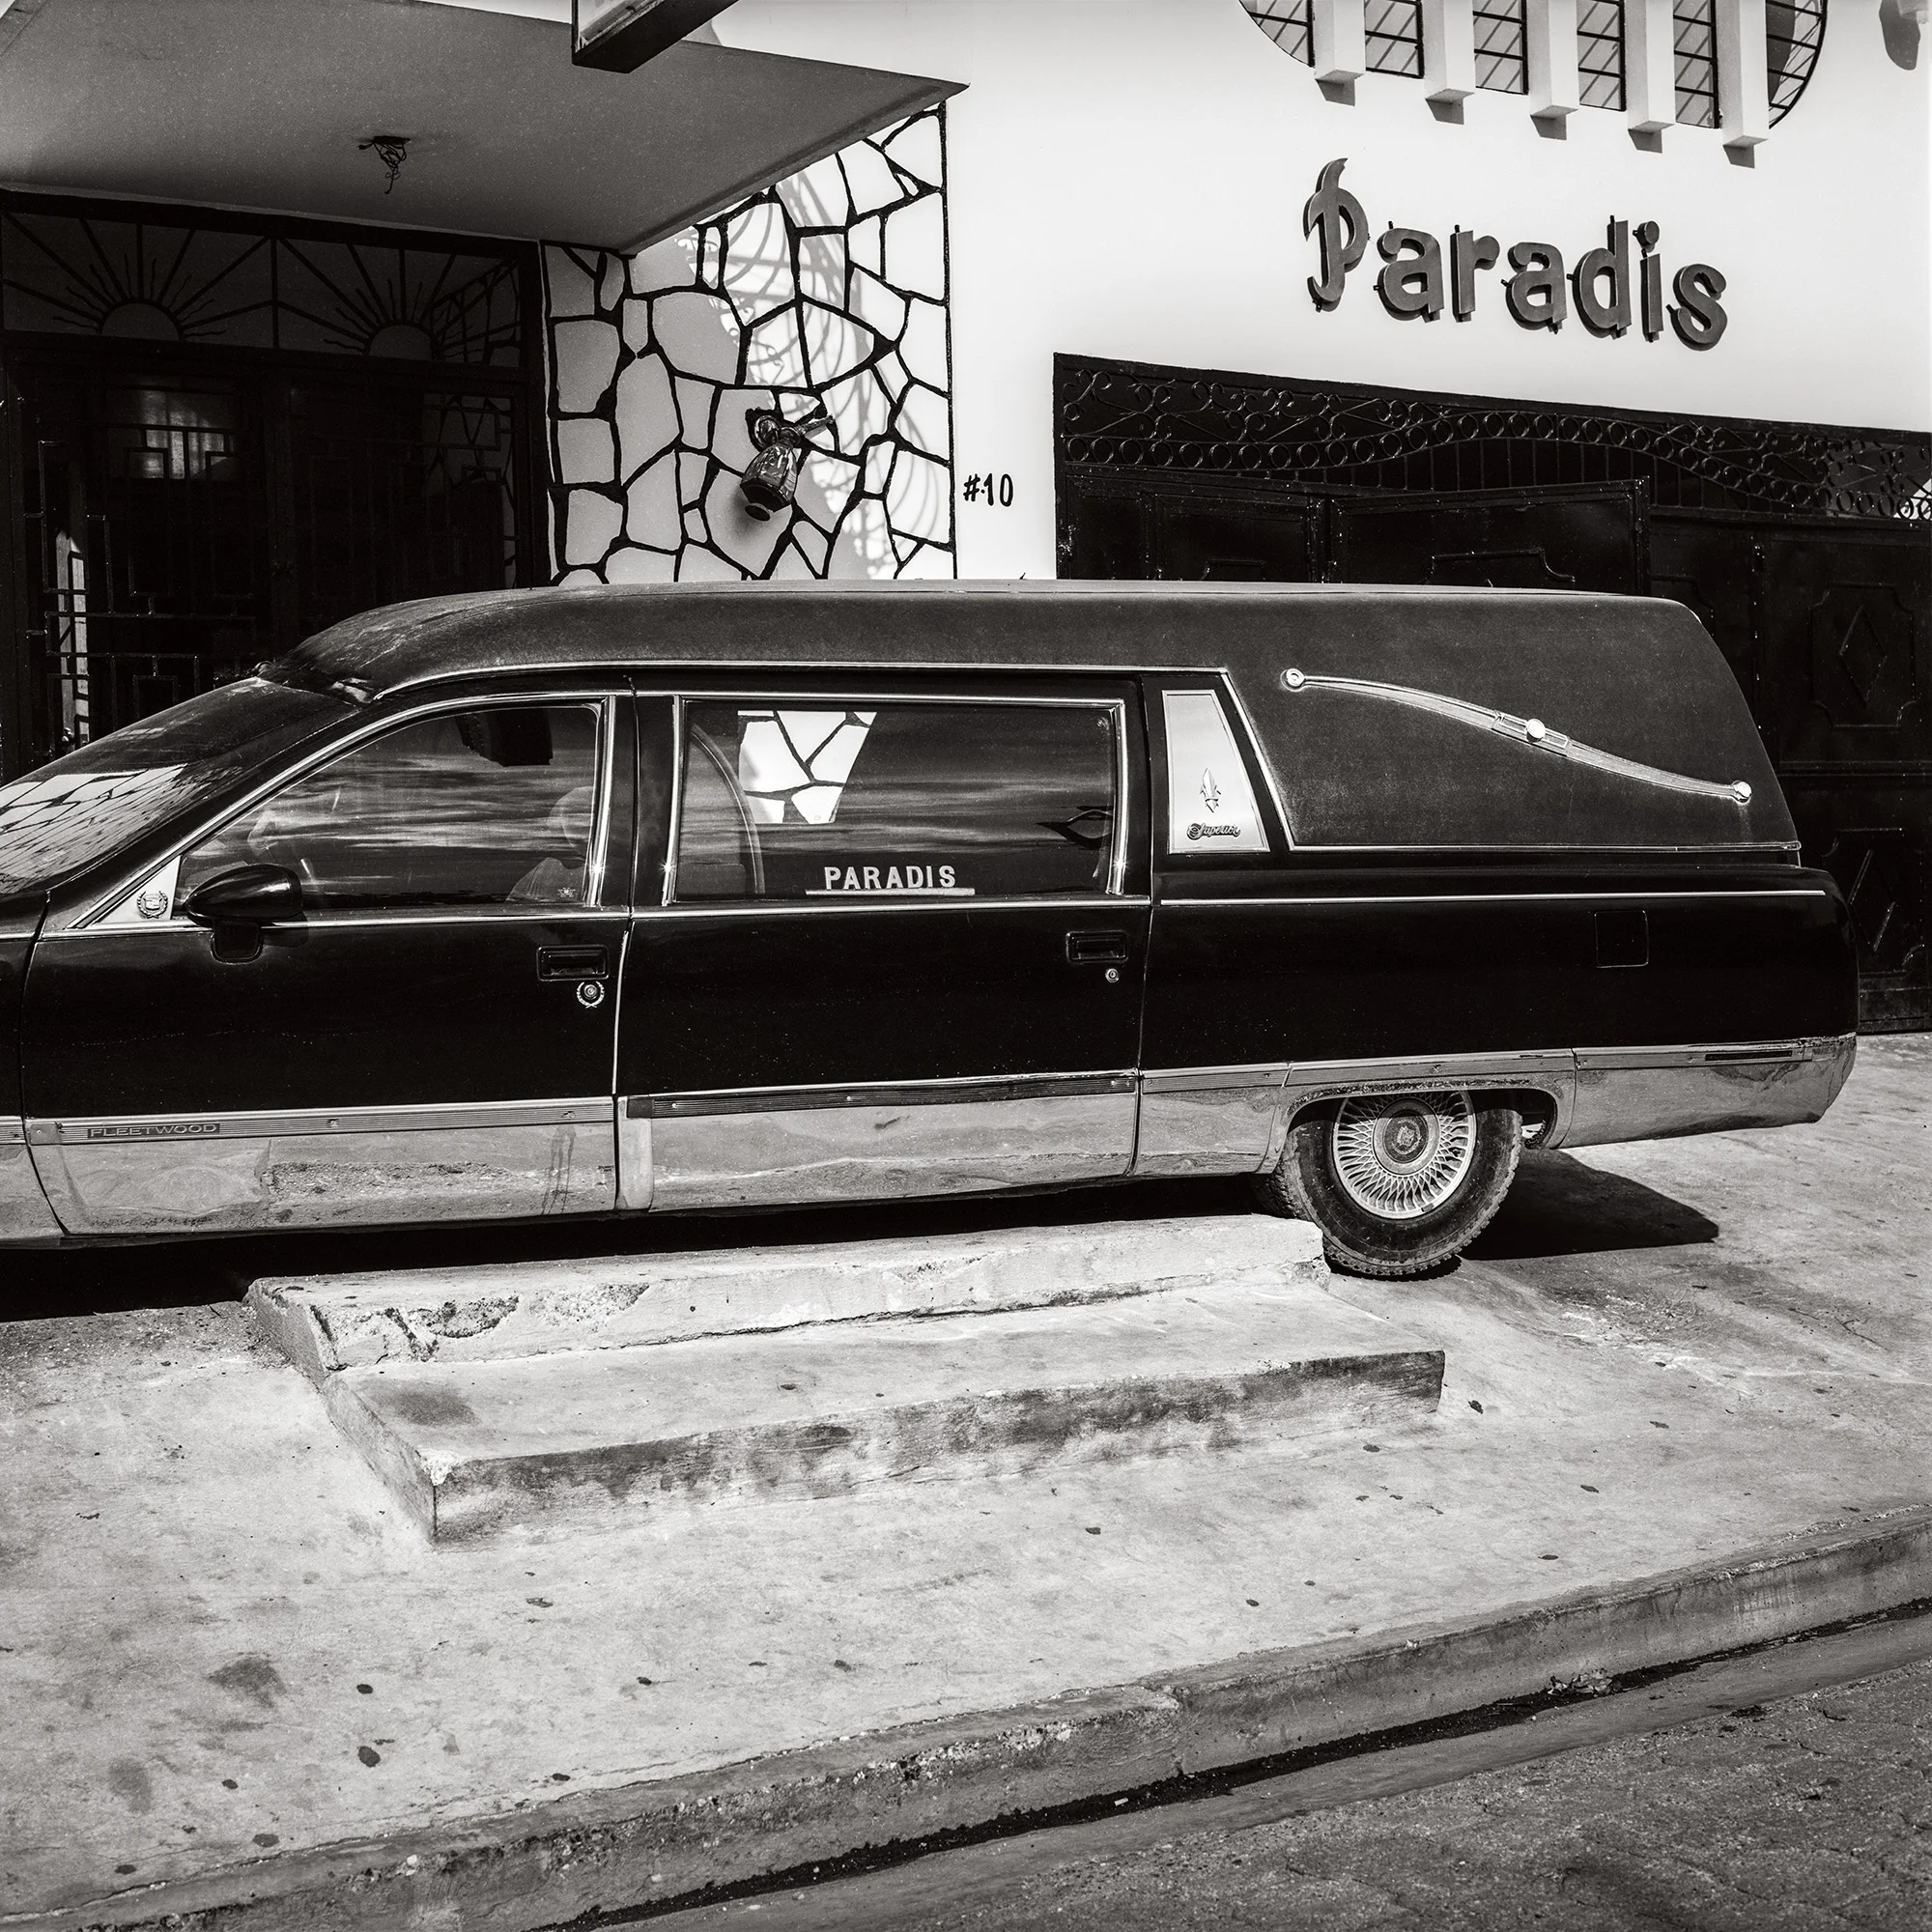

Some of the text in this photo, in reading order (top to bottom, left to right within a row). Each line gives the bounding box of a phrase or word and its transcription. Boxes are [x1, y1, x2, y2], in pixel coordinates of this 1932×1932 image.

[1303, 157, 1727, 352] Paradis
[824, 866, 956, 890] PARADIS
[90, 1123, 216, 1137] FLEETWOOD
